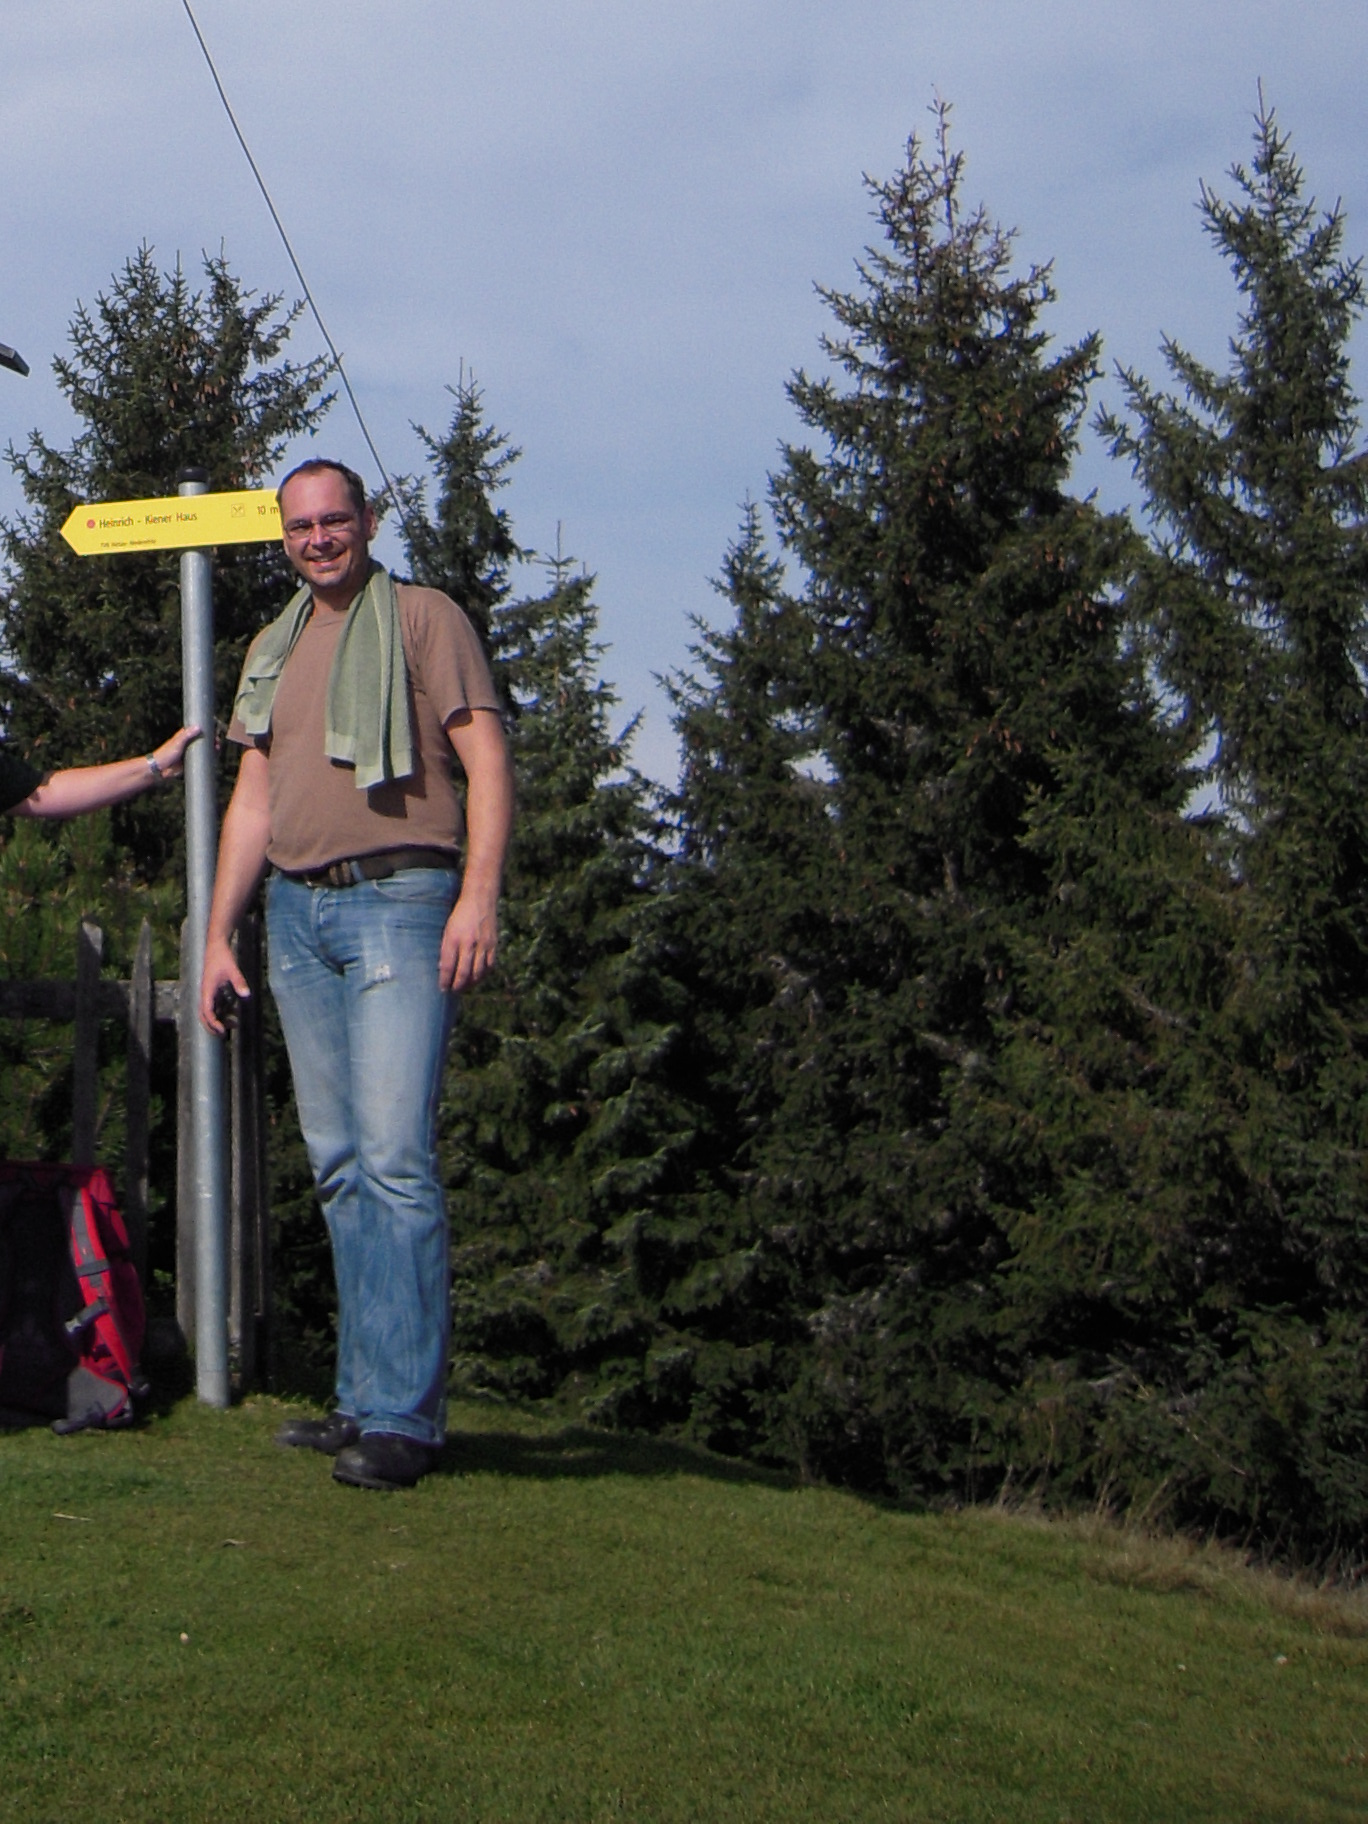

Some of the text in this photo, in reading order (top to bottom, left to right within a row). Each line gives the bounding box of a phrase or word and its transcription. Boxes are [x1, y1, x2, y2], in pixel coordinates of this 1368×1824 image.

[270, 506, 280, 514] m
[99, 516, 134, 529] Heinrich
[176, 512, 198, 522] Haus
